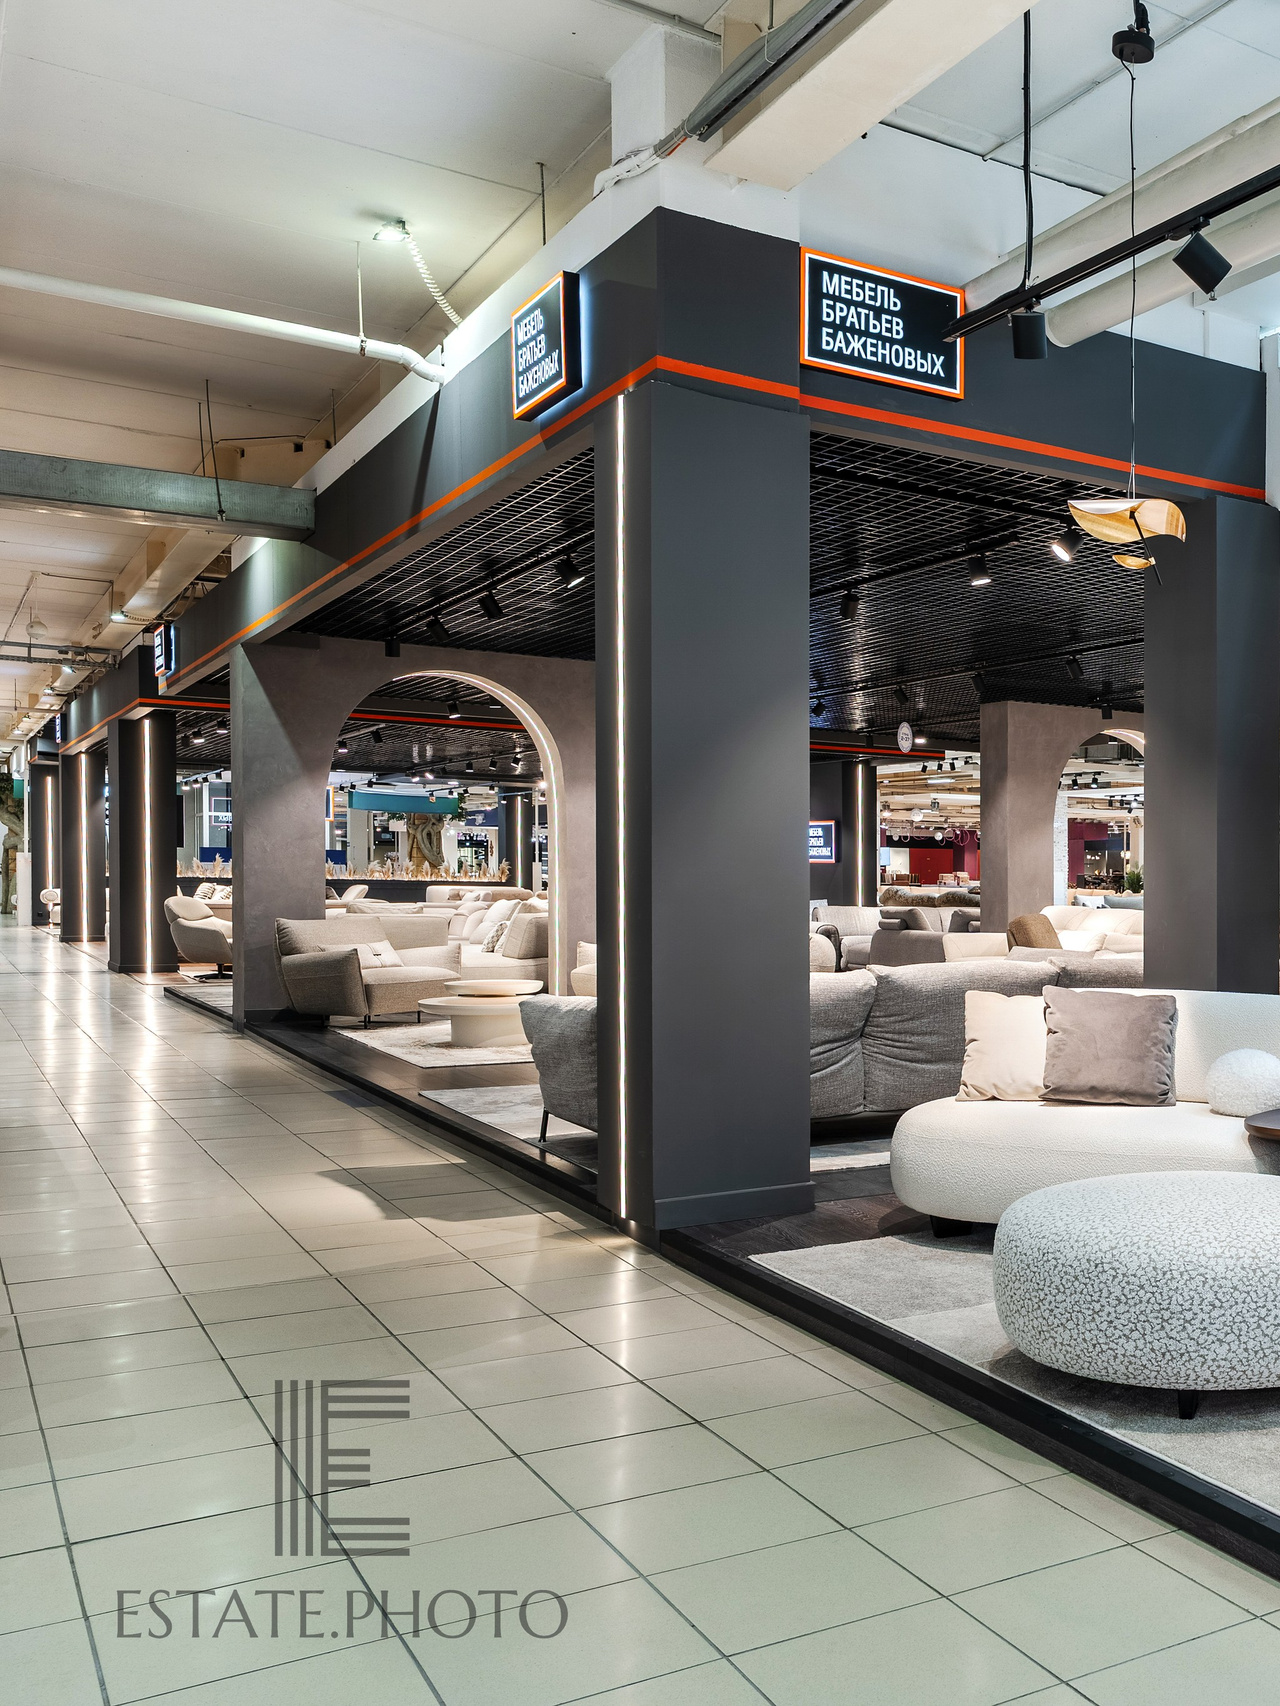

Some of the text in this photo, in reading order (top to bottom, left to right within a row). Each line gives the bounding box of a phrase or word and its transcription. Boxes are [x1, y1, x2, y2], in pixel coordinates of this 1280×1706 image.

[822, 270, 902, 312] МЕБЕЛЬ
[517, 307, 544, 346] МЕБЕЛЬ
[822, 298, 904, 340] БРАТЬЕВ
[517, 333, 546, 373] БРАТЬЕВ
[518, 349, 559, 398] БАЖЕНОВЫХ
[821, 327, 946, 378] БАЖЕНОВЫХ
